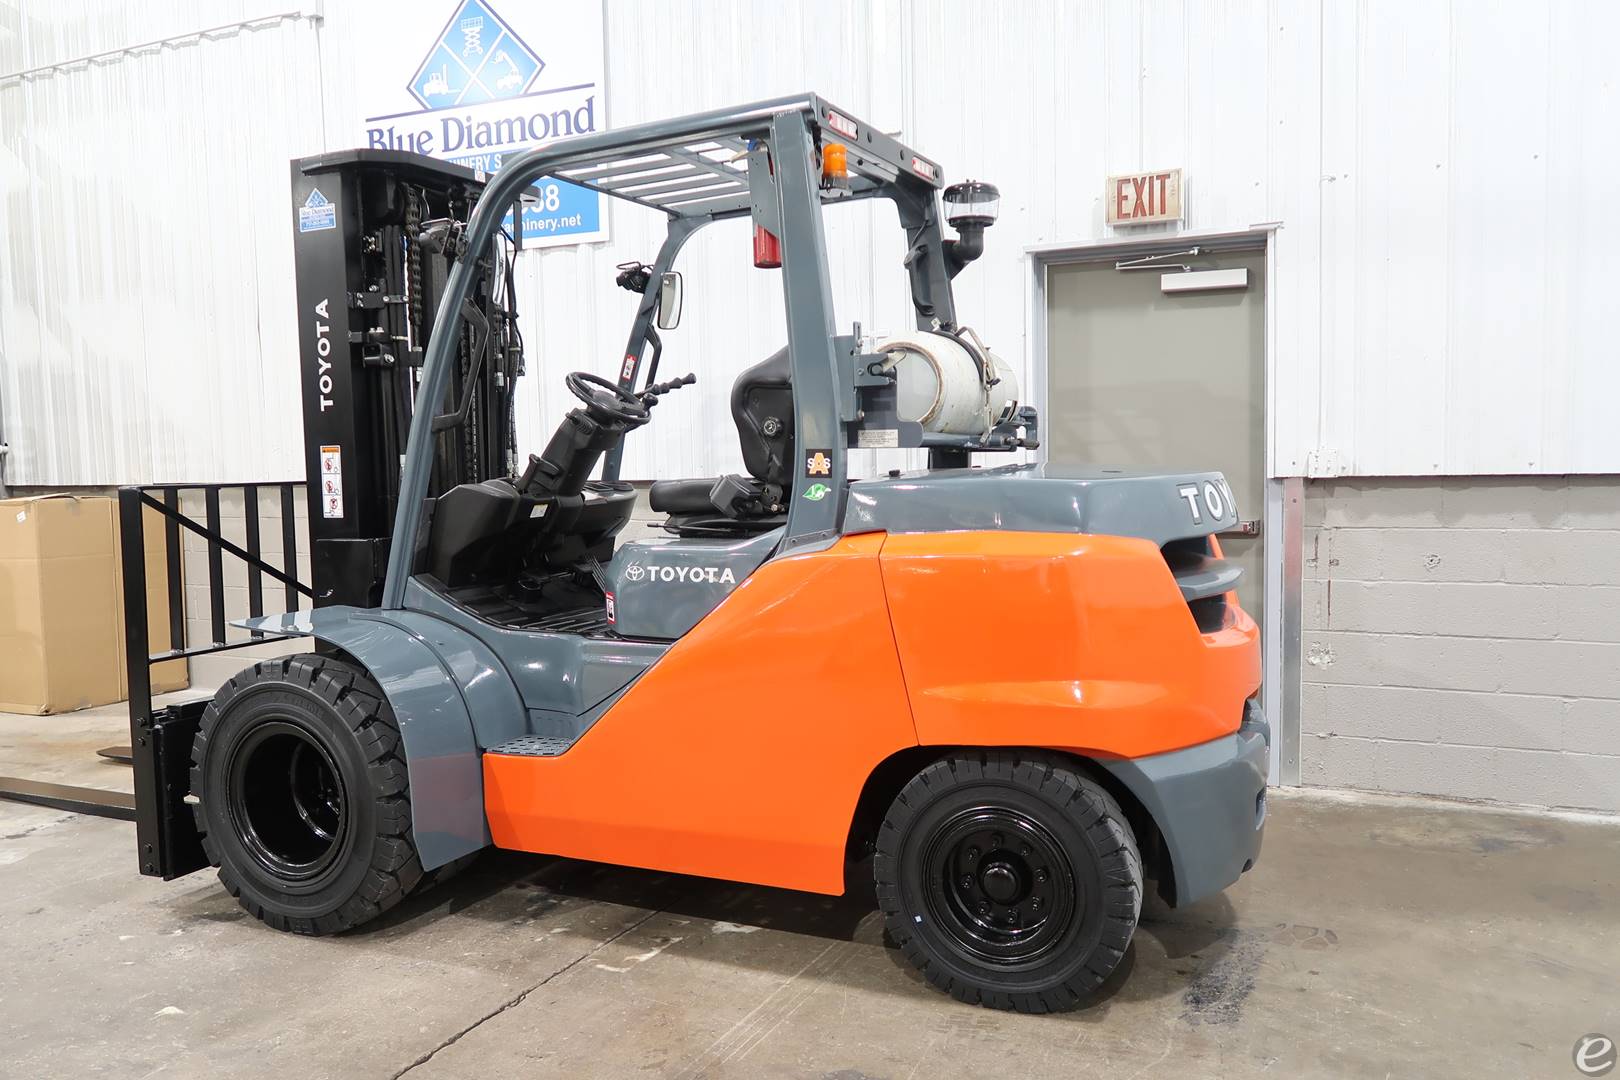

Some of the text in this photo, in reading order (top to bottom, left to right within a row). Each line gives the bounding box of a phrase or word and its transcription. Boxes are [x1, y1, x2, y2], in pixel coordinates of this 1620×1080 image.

[366, 96, 595, 155] Blue Diamond
[1117, 174, 1170, 219] EXIT
[315, 298, 334, 412] TOYOTA
[647, 566, 736, 584] TOYOTA
